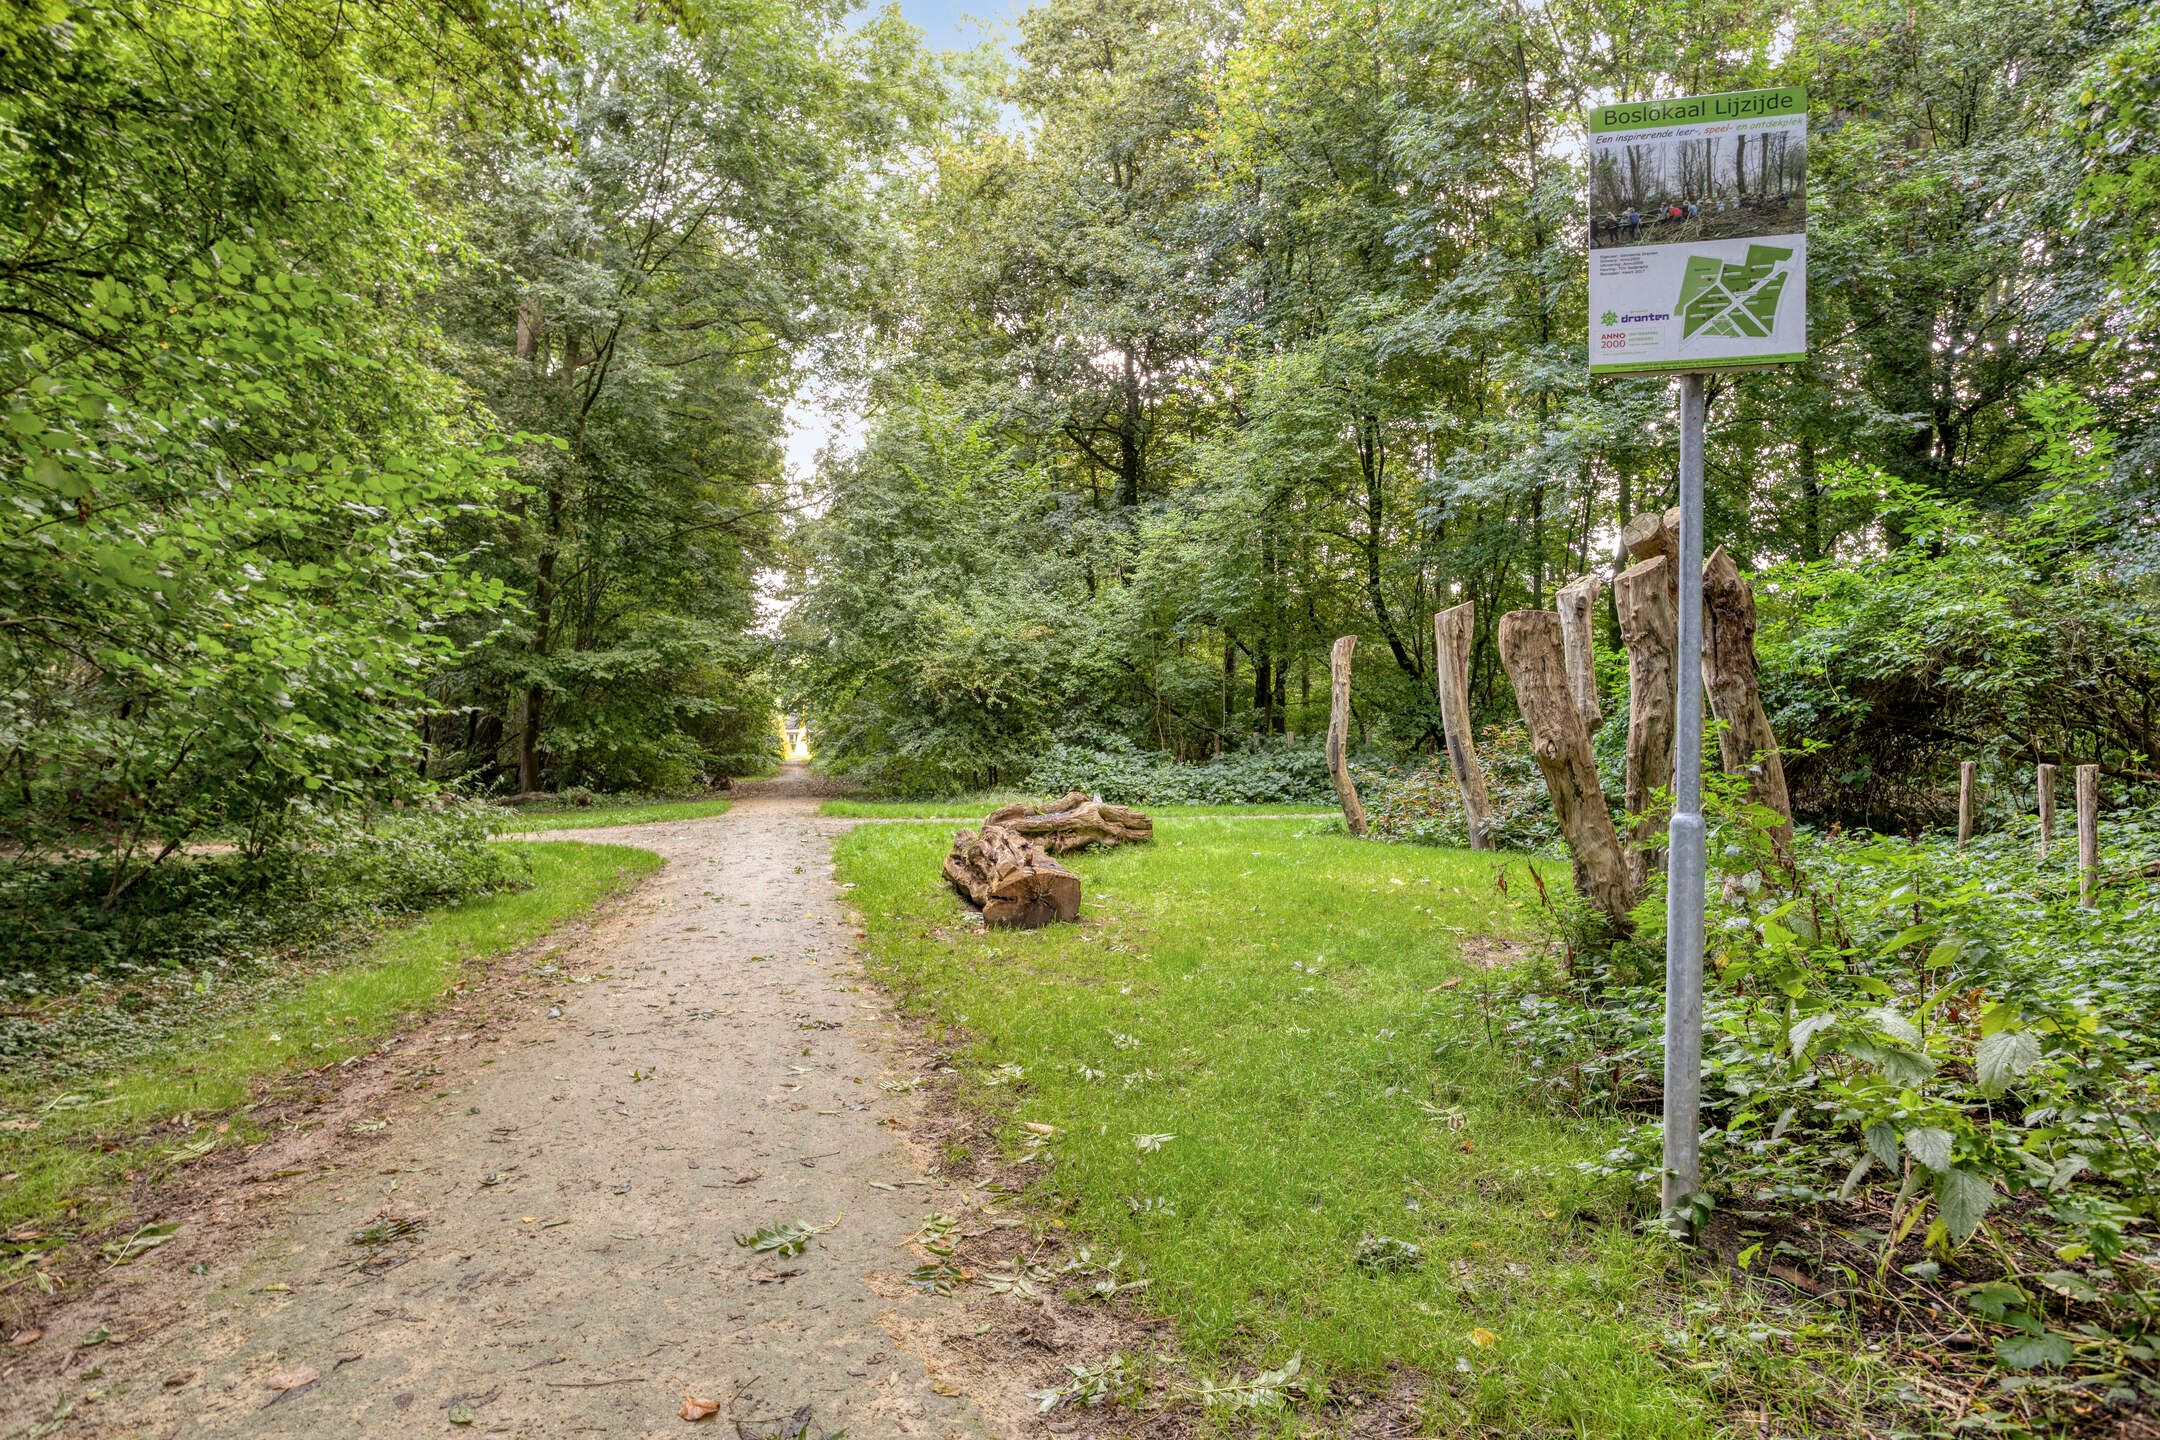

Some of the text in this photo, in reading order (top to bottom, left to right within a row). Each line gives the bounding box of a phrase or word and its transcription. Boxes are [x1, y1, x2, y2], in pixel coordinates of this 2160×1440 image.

[1604, 93, 1793, 126] Boslokaal Lijzijde
[1595, 135, 1613, 144] Een
[1615, 129, 1673, 143] inspirerende
[1703, 123, 1733, 135] speel-
[1736, 123, 1747, 131] en
[1621, 312, 1670, 323] dronten
[1601, 332, 1626, 340] ANNO
[1601, 340, 1626, 349] 2000
